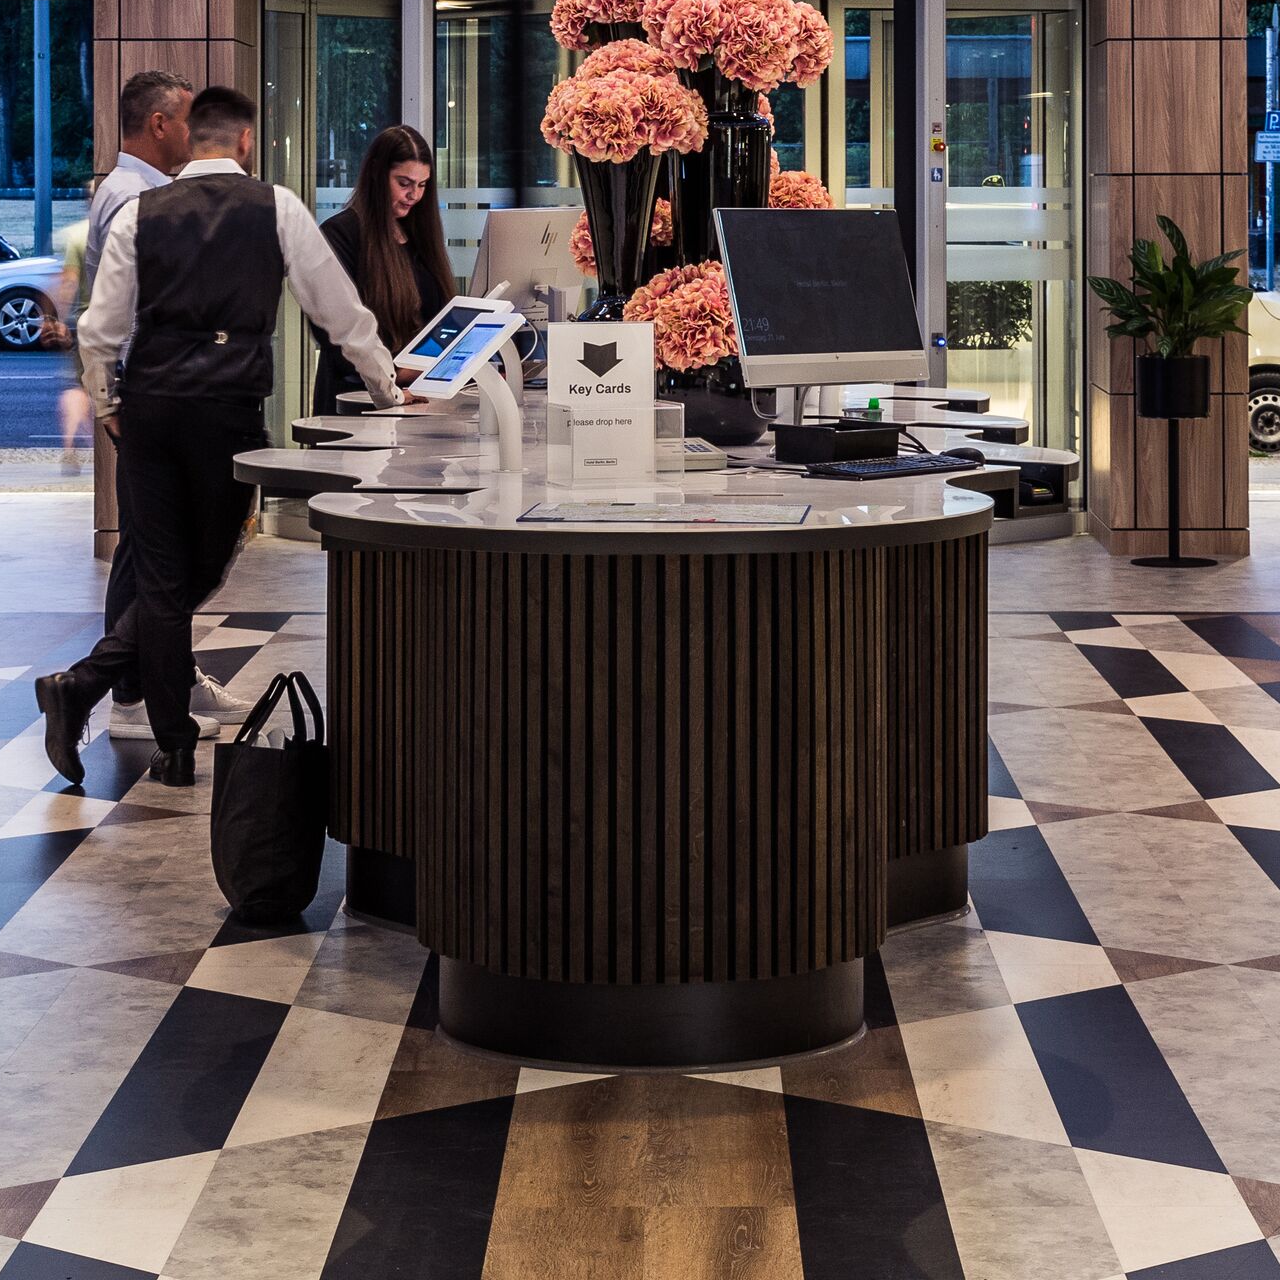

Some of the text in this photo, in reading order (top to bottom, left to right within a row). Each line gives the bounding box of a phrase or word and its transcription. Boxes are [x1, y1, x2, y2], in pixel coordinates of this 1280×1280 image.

[742, 317, 770, 332] 21:49
[569, 383, 631, 396] Key Cards
[595, 418, 613, 427] drop
[615, 417, 632, 426] here
